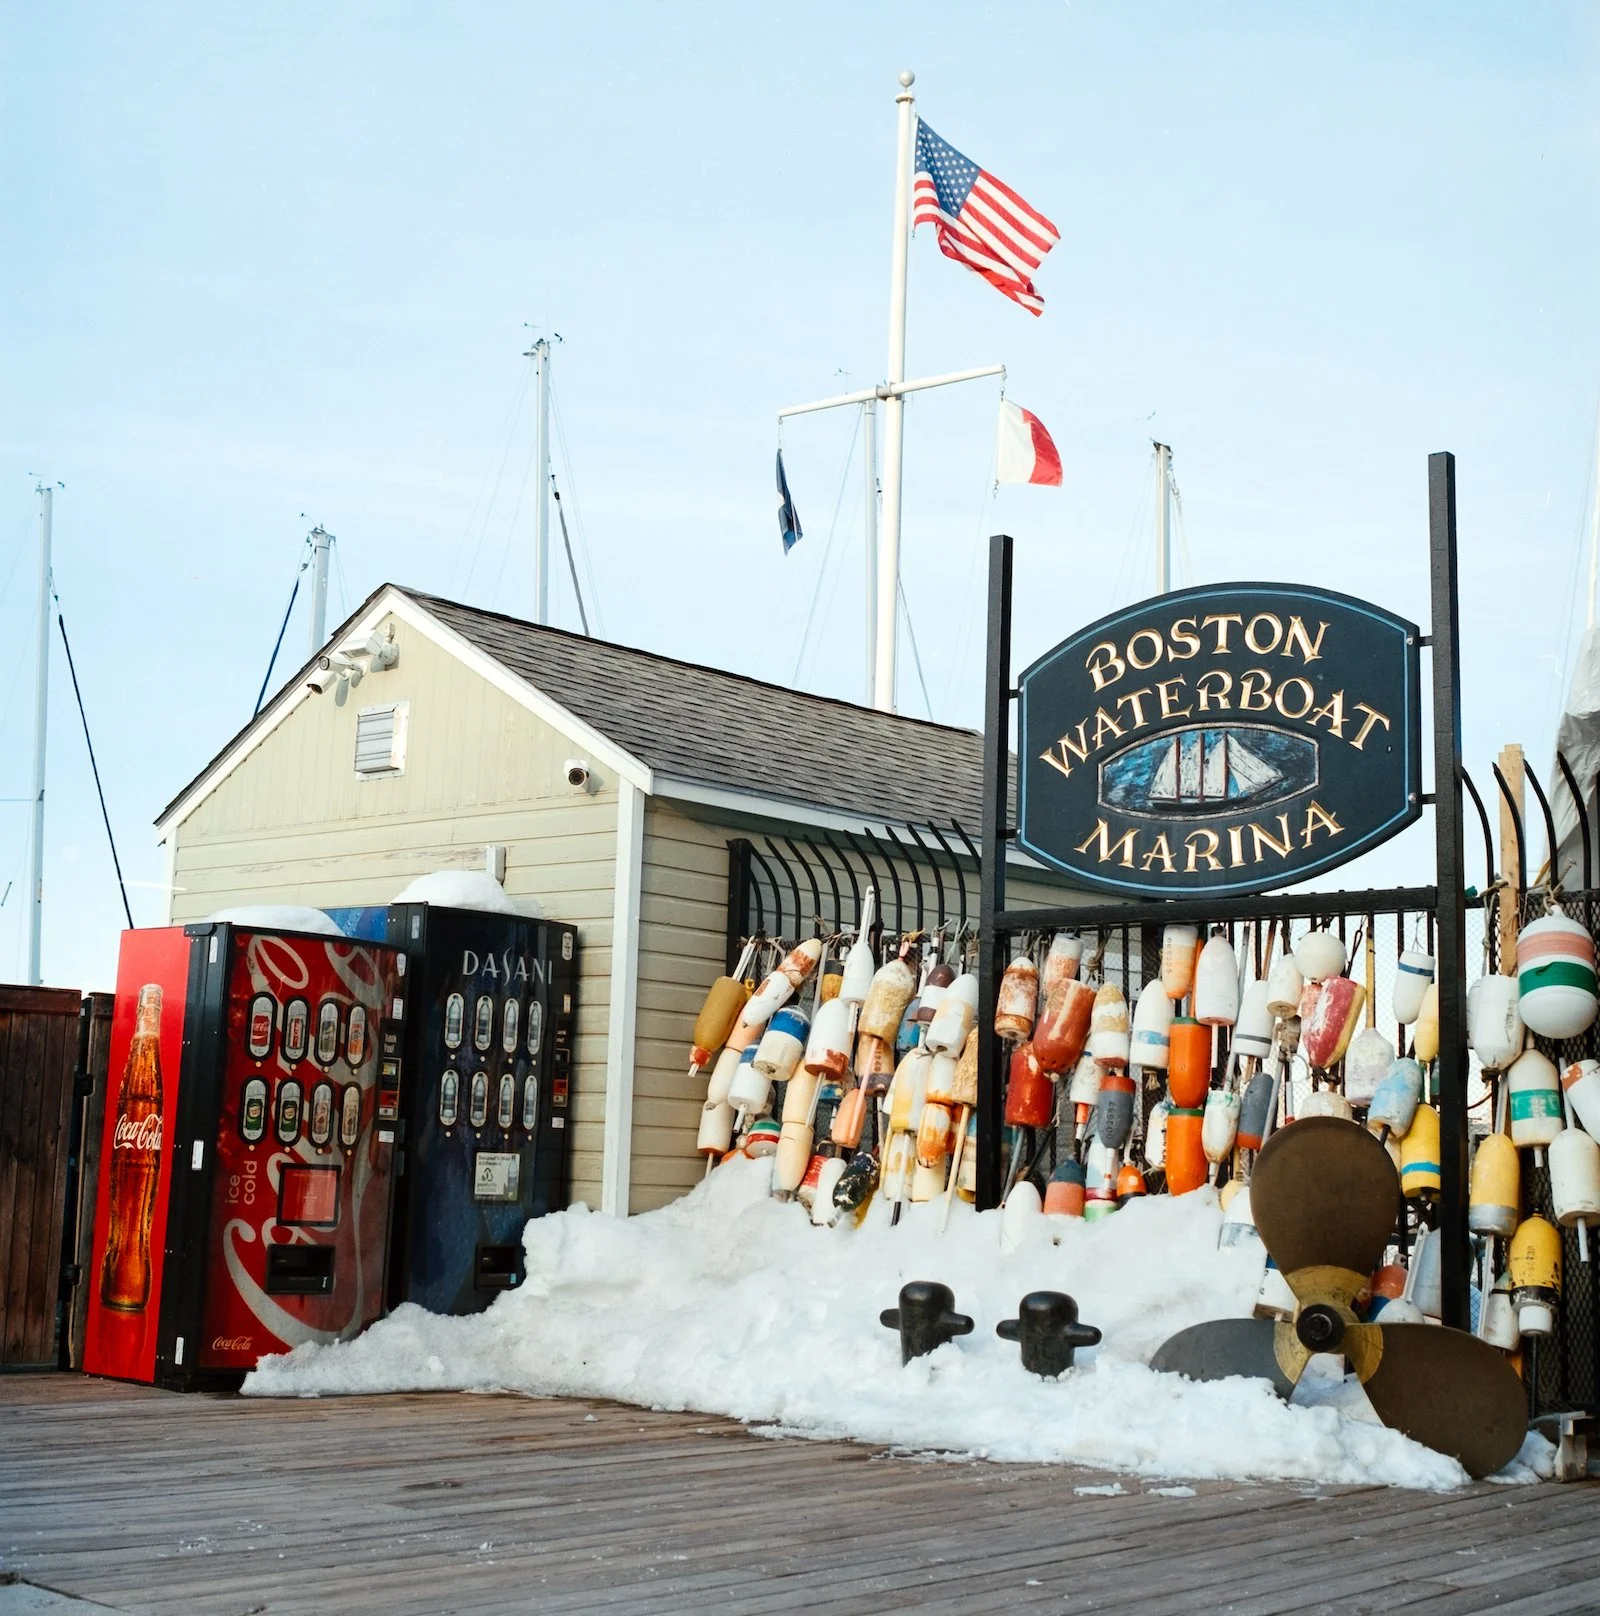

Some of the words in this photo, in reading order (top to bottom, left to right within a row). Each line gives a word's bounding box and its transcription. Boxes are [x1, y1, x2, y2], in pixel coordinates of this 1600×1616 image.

[1085, 611, 1332, 693] BOSTON
[1038, 667, 1392, 778] WATERBOAT
[1073, 799, 1346, 874] MARINA
[462, 947, 553, 987] DASANI
[113, 1113, 163, 1151] Coca-Cola
[224, 1174, 241, 1204] ice
[241, 1160, 258, 1206] cold
[212, 1335, 253, 1351] Coca-Cola
